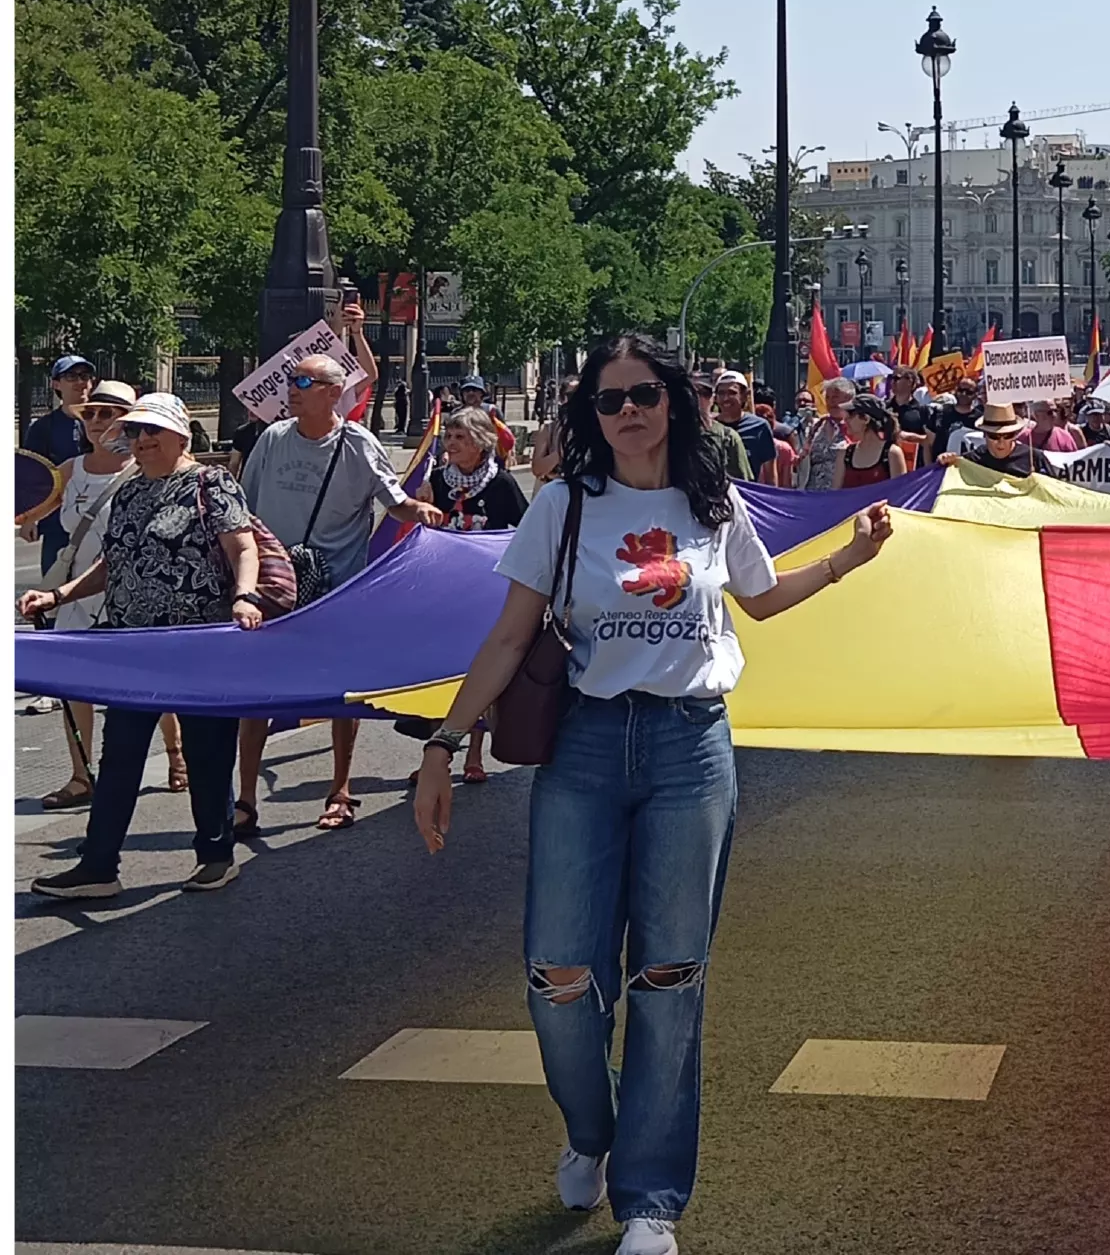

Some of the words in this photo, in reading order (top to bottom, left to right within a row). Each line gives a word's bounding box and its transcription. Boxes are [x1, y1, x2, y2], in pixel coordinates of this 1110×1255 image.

[984, 346, 1028, 366] Democracia
[1029, 349, 1044, 363] con
[1044, 348, 1067, 365] reyes,
[987, 372, 1021, 391] Porsche
[1021, 374, 1037, 388] con
[1037, 370, 1068, 391] bueyes.
[599, 610, 642, 621] Ateneo
